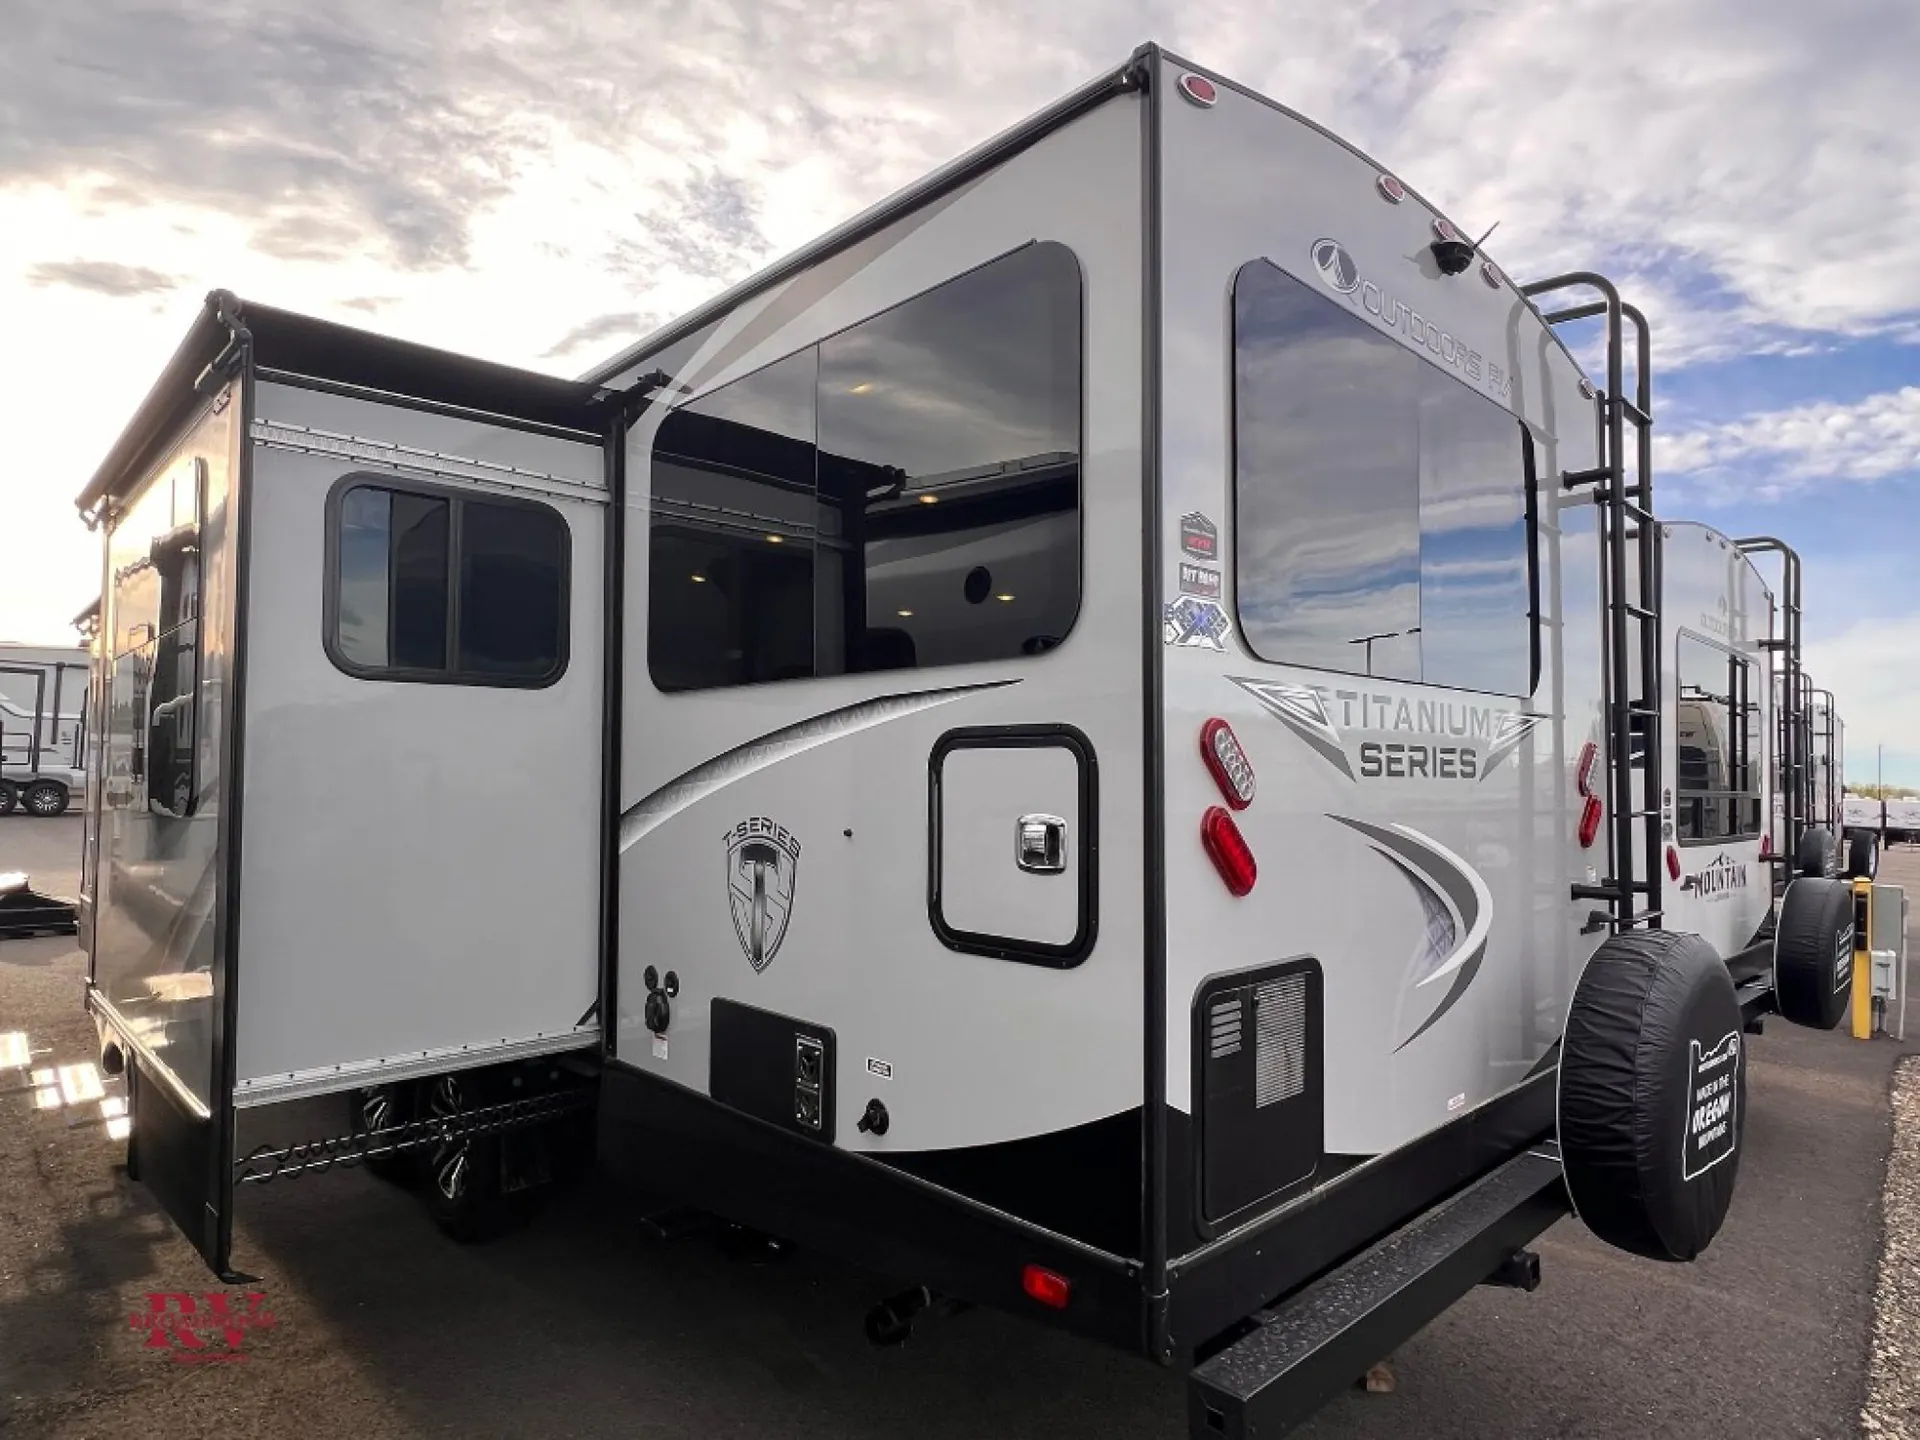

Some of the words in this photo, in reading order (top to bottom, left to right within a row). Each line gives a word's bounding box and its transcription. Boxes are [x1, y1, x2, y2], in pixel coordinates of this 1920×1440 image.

[1362, 279, 1483, 382] OUTDOORS
[1336, 689, 1491, 738] TITANIUM
[1360, 742, 1477, 779] SERIES
[722, 816, 801, 859] T-SERIES
[1693, 864, 1746, 899] MOUNTAIN
